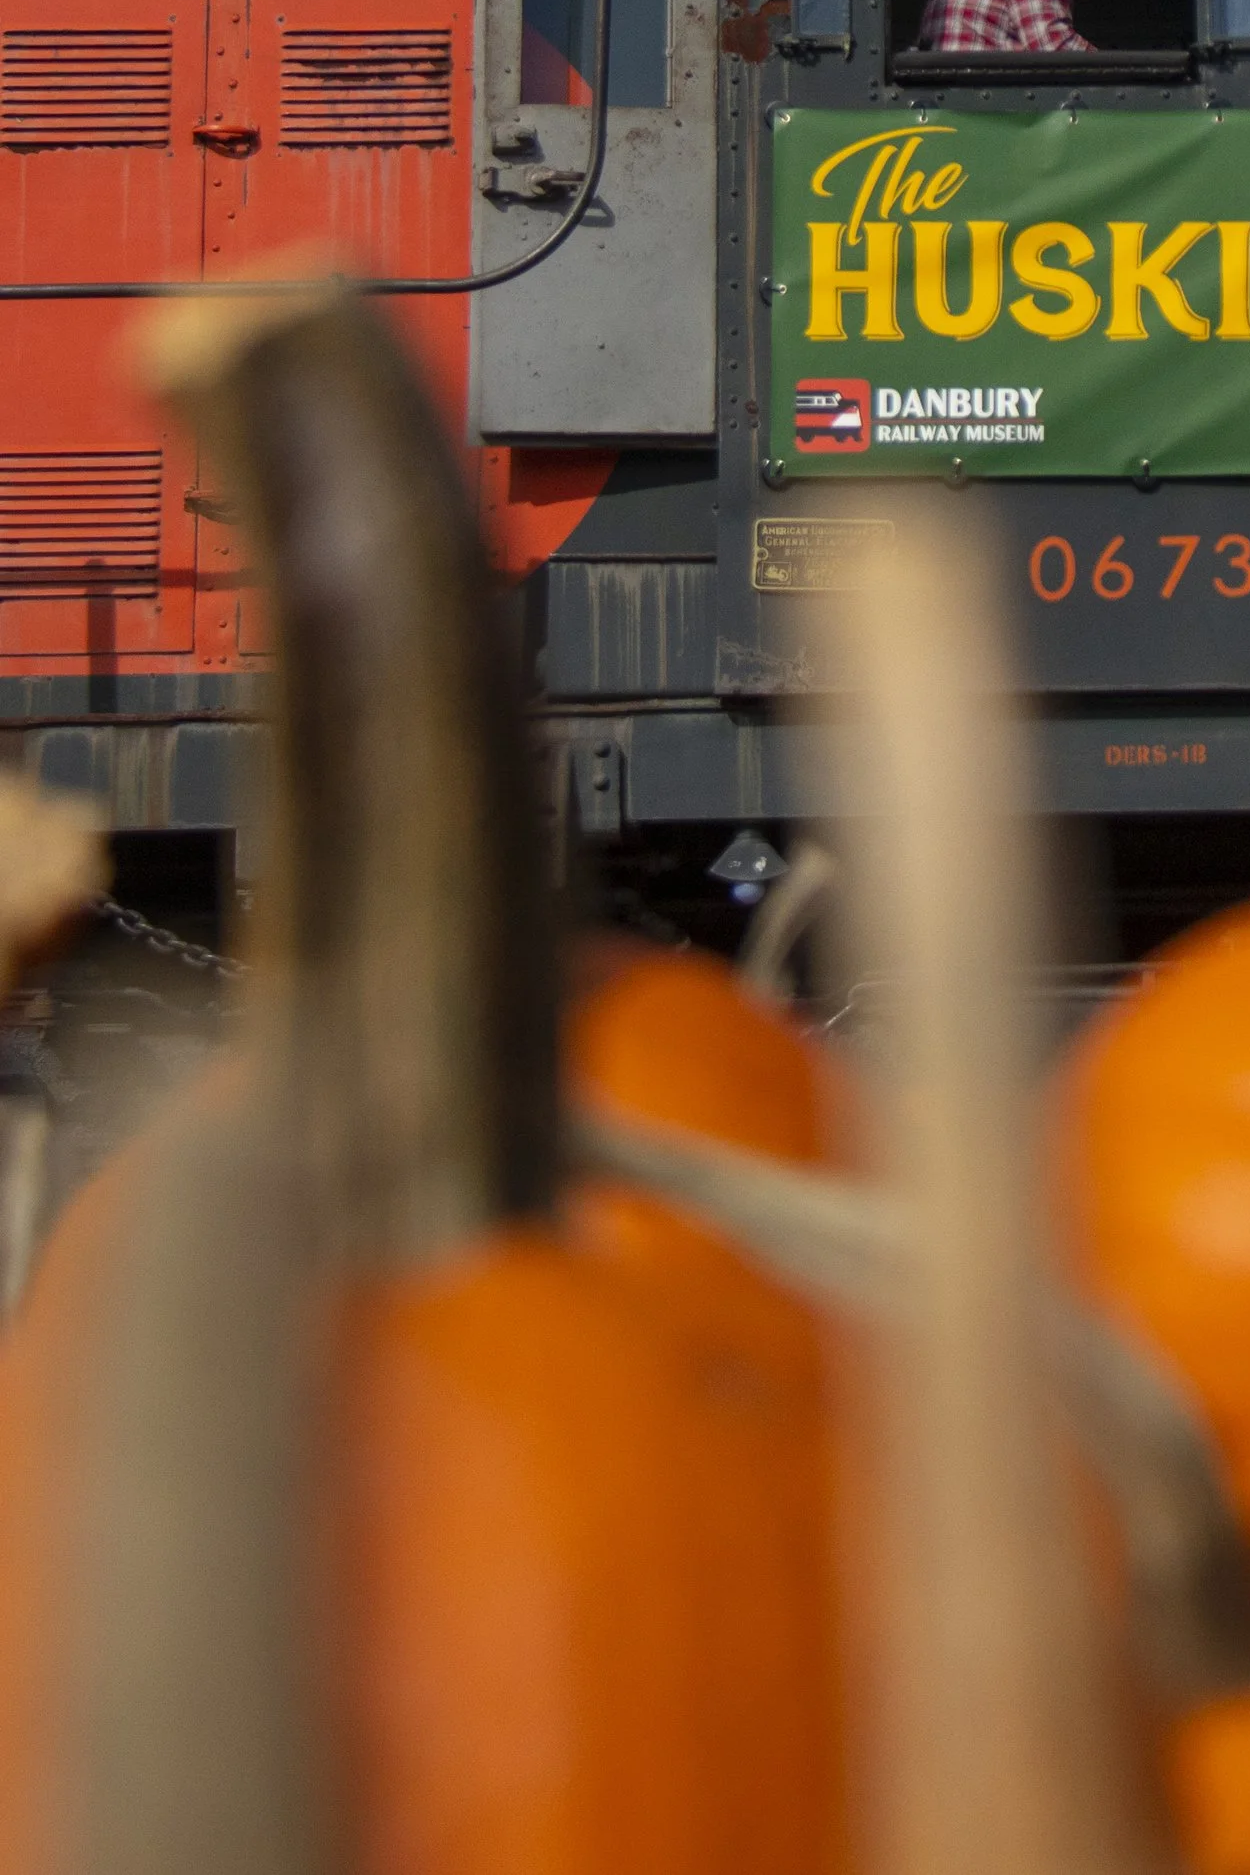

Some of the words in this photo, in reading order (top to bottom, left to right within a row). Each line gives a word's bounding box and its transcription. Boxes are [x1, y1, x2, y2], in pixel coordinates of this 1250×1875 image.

[811, 126, 968, 245] The
[877, 387, 1044, 419] DANBURY
[877, 424, 962, 443] RAILWAY
[965, 424, 1045, 443] MUSEUM
